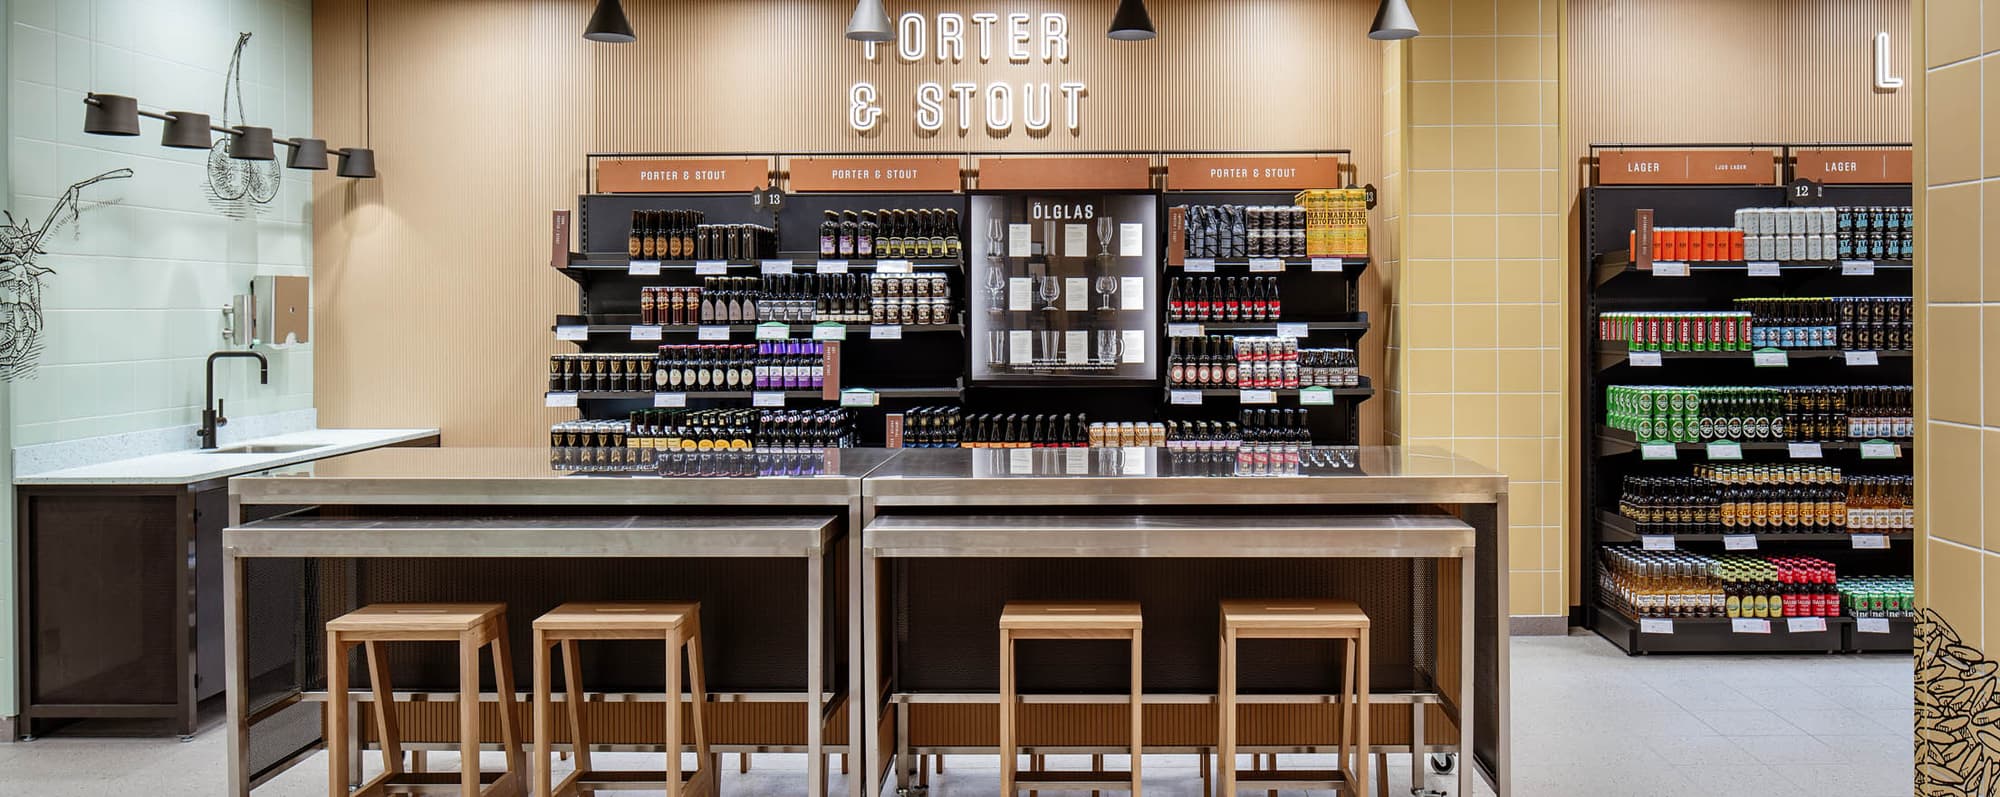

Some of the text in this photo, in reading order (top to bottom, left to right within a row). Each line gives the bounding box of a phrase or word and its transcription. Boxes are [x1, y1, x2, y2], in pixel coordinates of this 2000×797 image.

[849, 81, 1086, 130] & STOUT
[1627, 163, 1660, 172] LAGER
[1825, 162, 1857, 172] LAGER
[640, 170, 727, 181] PORTER & STOUT
[831, 169, 918, 180] PORTER & STOUT
[1210, 168, 1297, 179] PORTER & STOUT
[1795, 185, 1809, 197] 12
[769, 193, 781, 205] 13
[1033, 202, 1094, 219] ÖLGLAS
